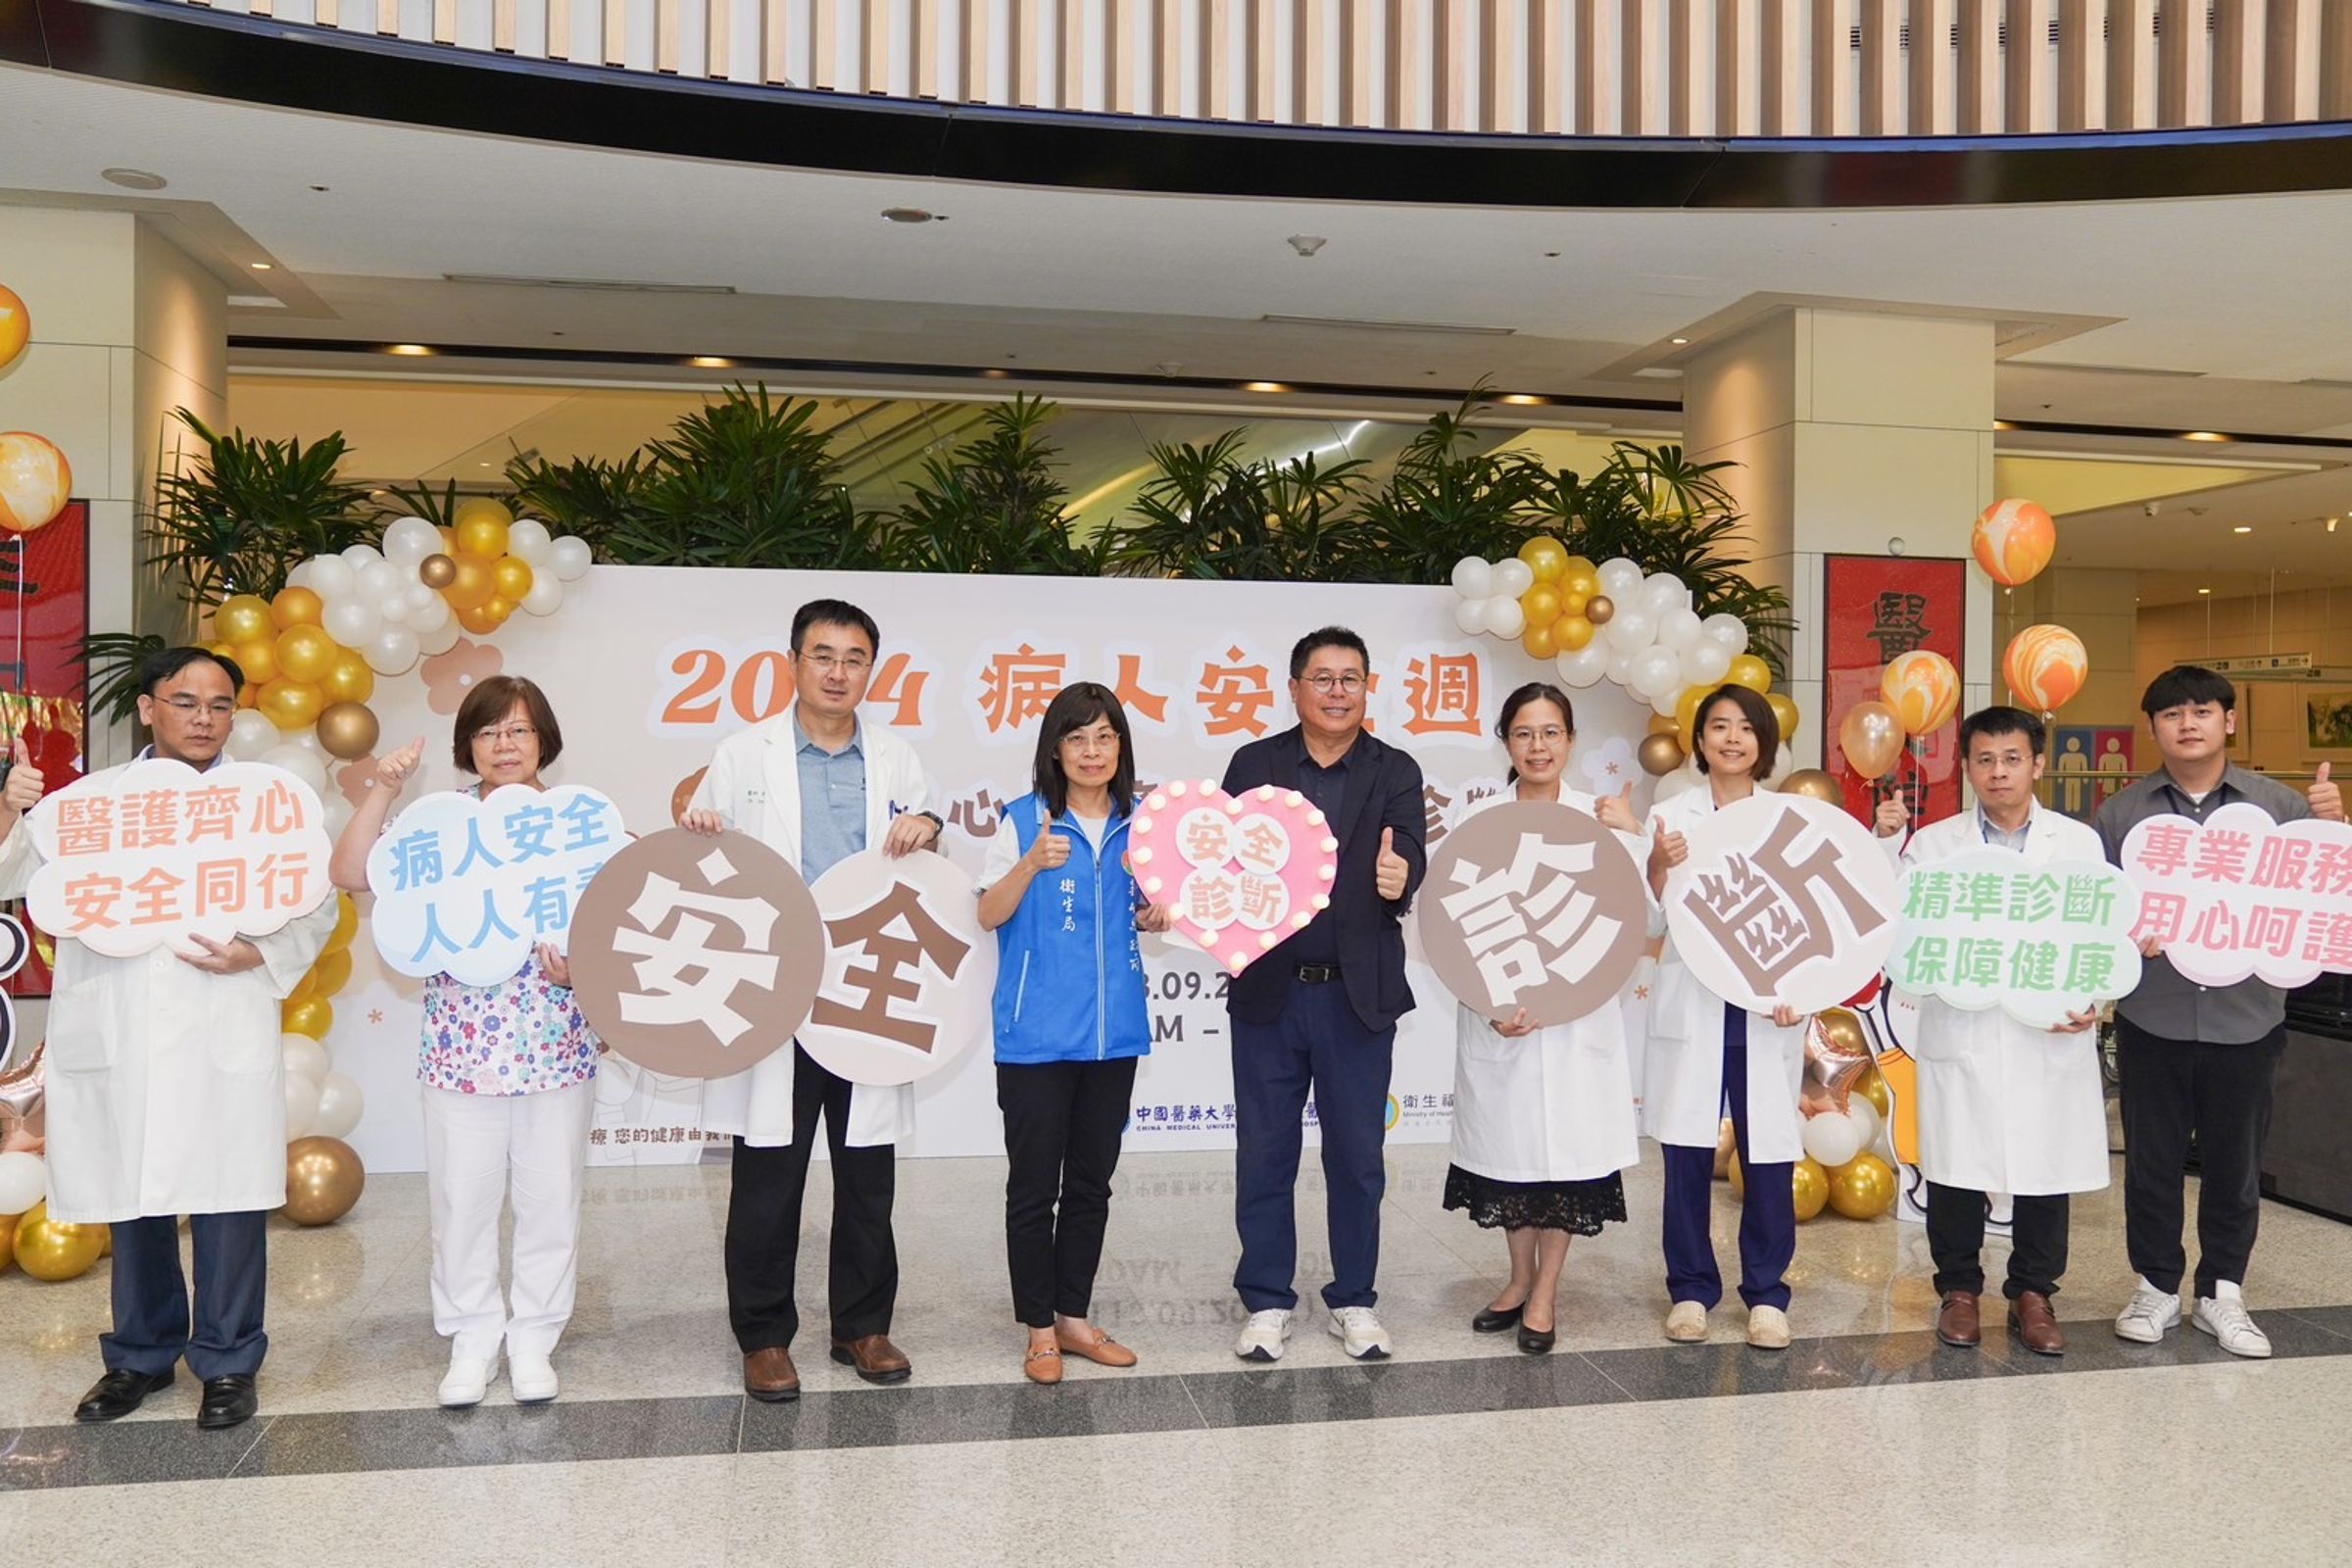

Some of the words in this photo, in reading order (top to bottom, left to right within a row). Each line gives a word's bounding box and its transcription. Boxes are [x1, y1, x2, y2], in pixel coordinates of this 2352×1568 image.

[661, 649, 930, 725] 204
[977, 642, 1483, 738] 病人安週
[56, 779, 306, 858] 醫護齊心
[388, 793, 611, 892] 病人安全
[1186, 812, 1284, 868] 安全
[64, 852, 309, 932] 安全同行
[1189, 875, 1282, 924] 診斷
[1901, 870, 2117, 927] 精準診斷
[2136, 824, 2352, 898] 專業服務
[1059, 877, 1076, 932] 衛生局
[1439, 831, 1624, 1008] 診
[1682, 806, 1886, 998] 斷
[2127, 890, 2352, 969] 用心呵護
[612, 847, 781, 1048] 安
[809, 880, 971, 1054] 全
[1903, 935, 2117, 994] 保障健康
[1402, 1094, 1454, 1108] 衛生福
